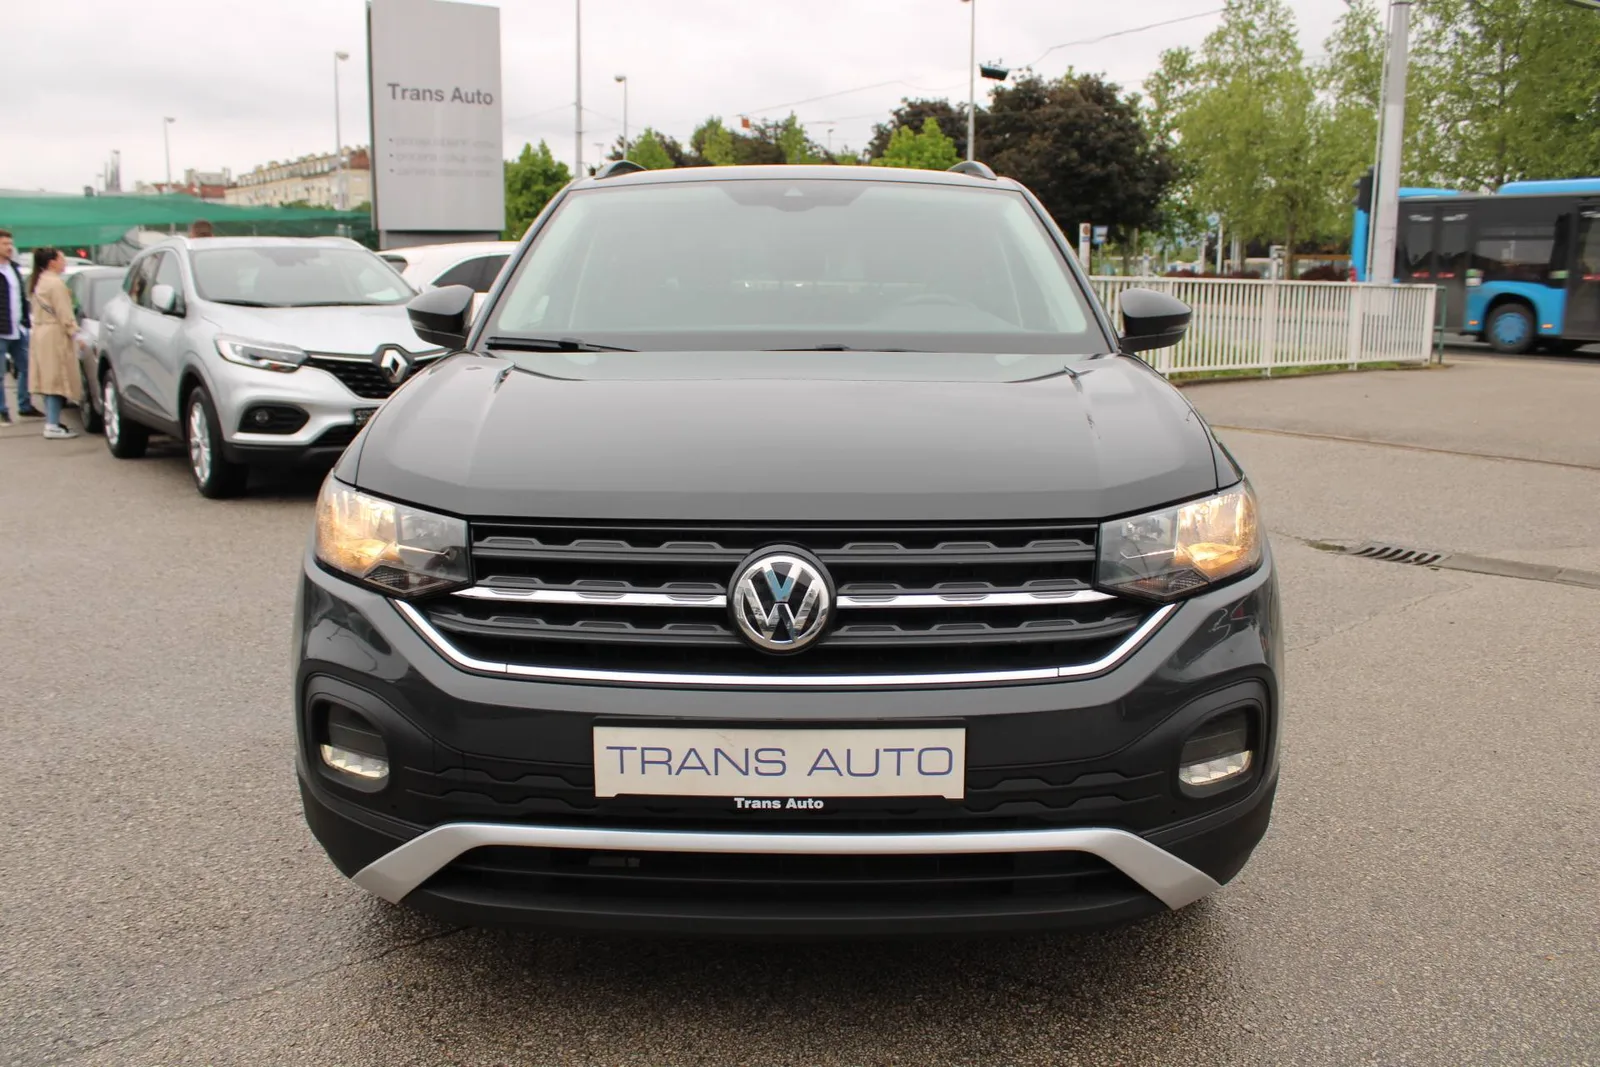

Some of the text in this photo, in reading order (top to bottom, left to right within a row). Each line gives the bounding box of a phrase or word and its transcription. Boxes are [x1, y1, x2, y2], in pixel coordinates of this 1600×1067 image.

[388, 83, 493, 105] Trans Auto
[606, 745, 954, 777] TRANS AUTO
[734, 797, 824, 809] Trans Auto
